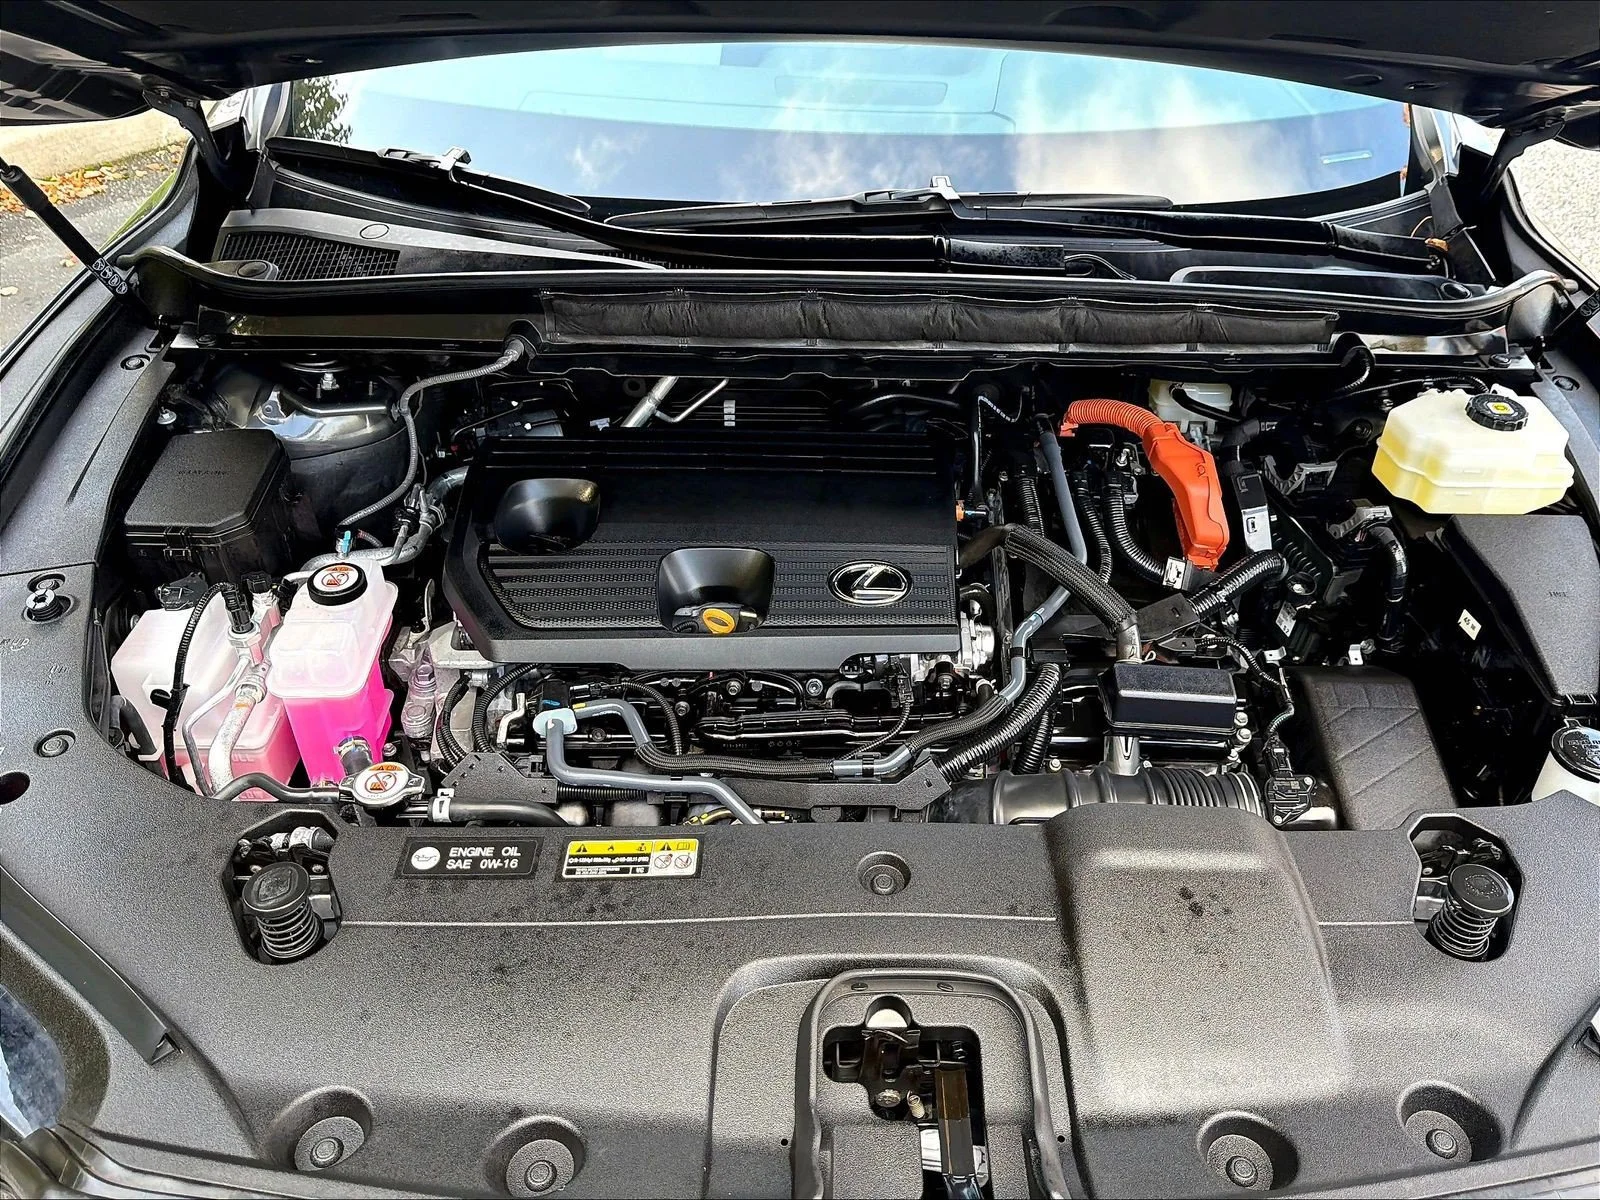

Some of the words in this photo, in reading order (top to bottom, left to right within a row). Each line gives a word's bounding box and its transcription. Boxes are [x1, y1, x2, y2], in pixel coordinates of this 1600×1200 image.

[448, 846, 495, 857] ENGINE
[501, 846, 521, 857] OIL
[446, 859, 473, 870] SAE
[480, 858, 519, 869] 0W-16
